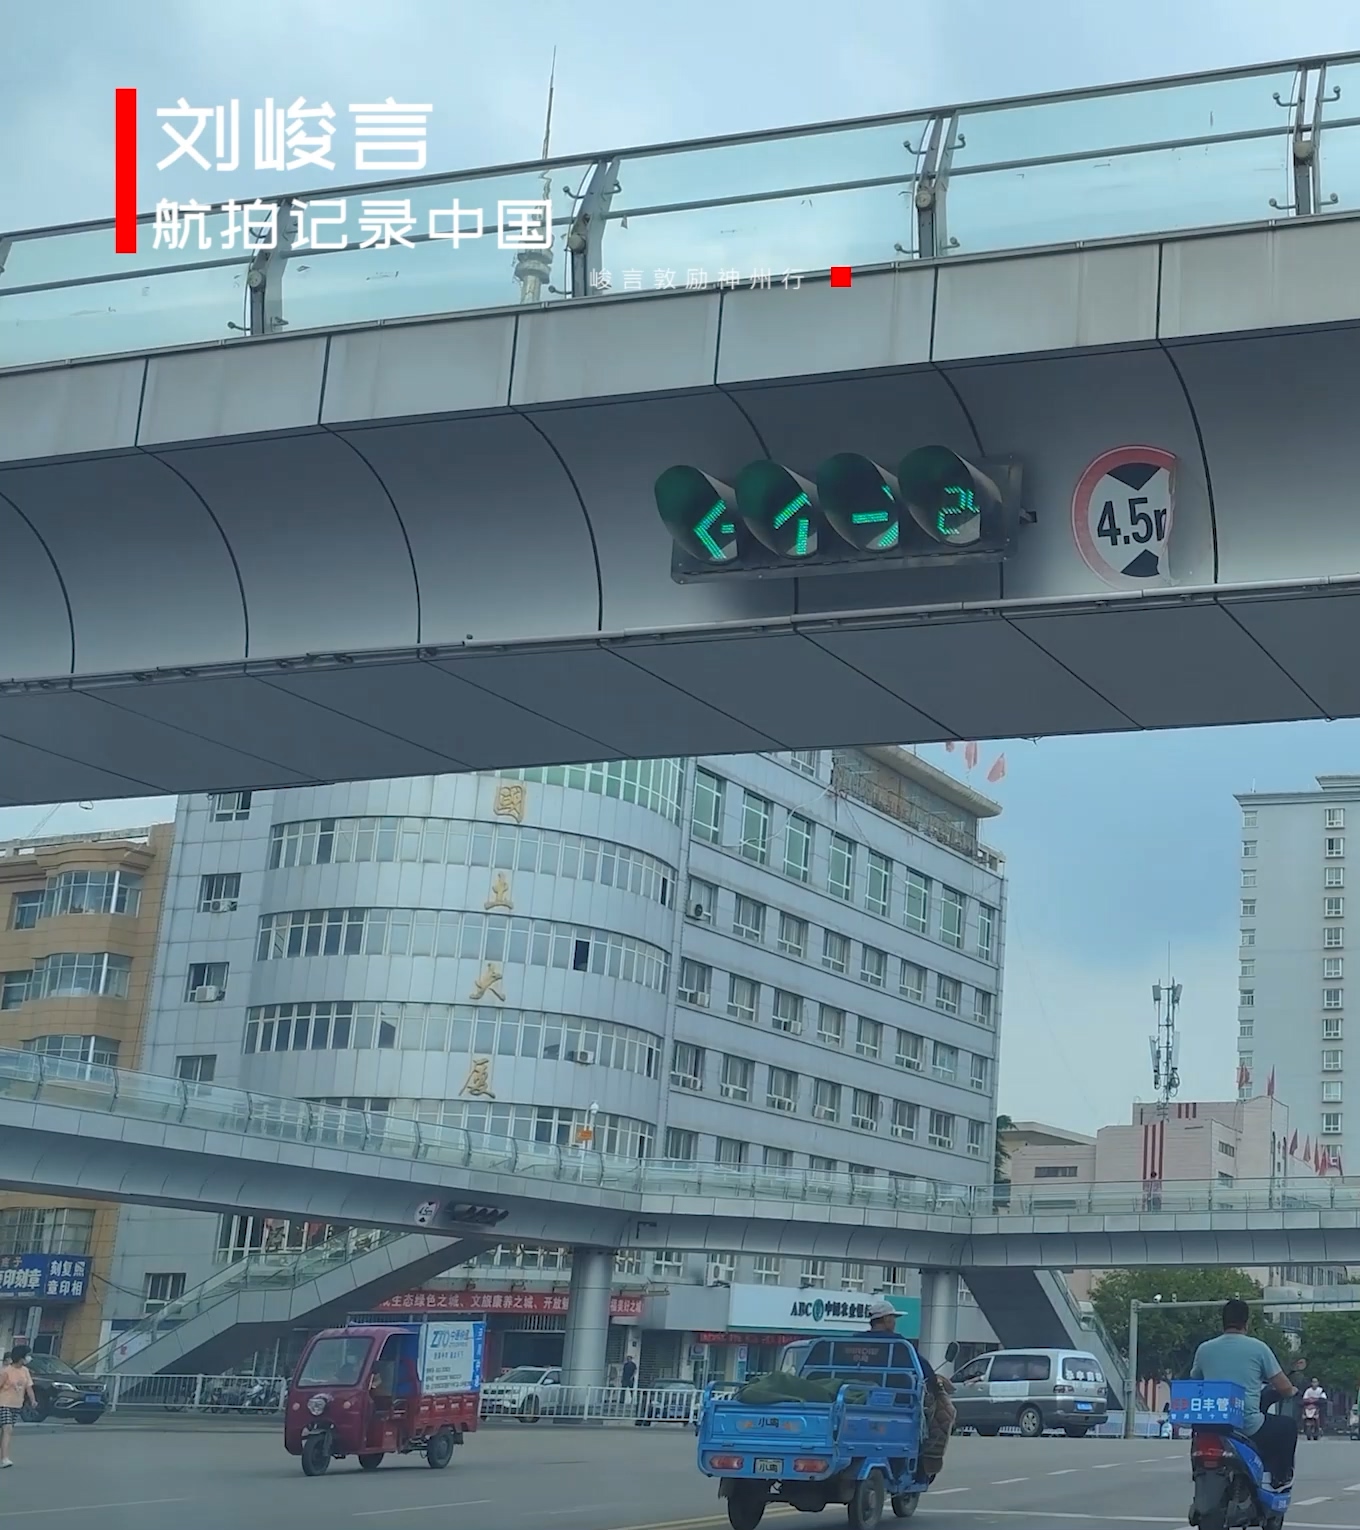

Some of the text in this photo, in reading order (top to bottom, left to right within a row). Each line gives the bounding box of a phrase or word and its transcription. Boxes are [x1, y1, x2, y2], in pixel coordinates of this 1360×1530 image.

[790, 1301, 812, 1317] ABC
[1191, 1398, 1229, 1412] 日丰管
